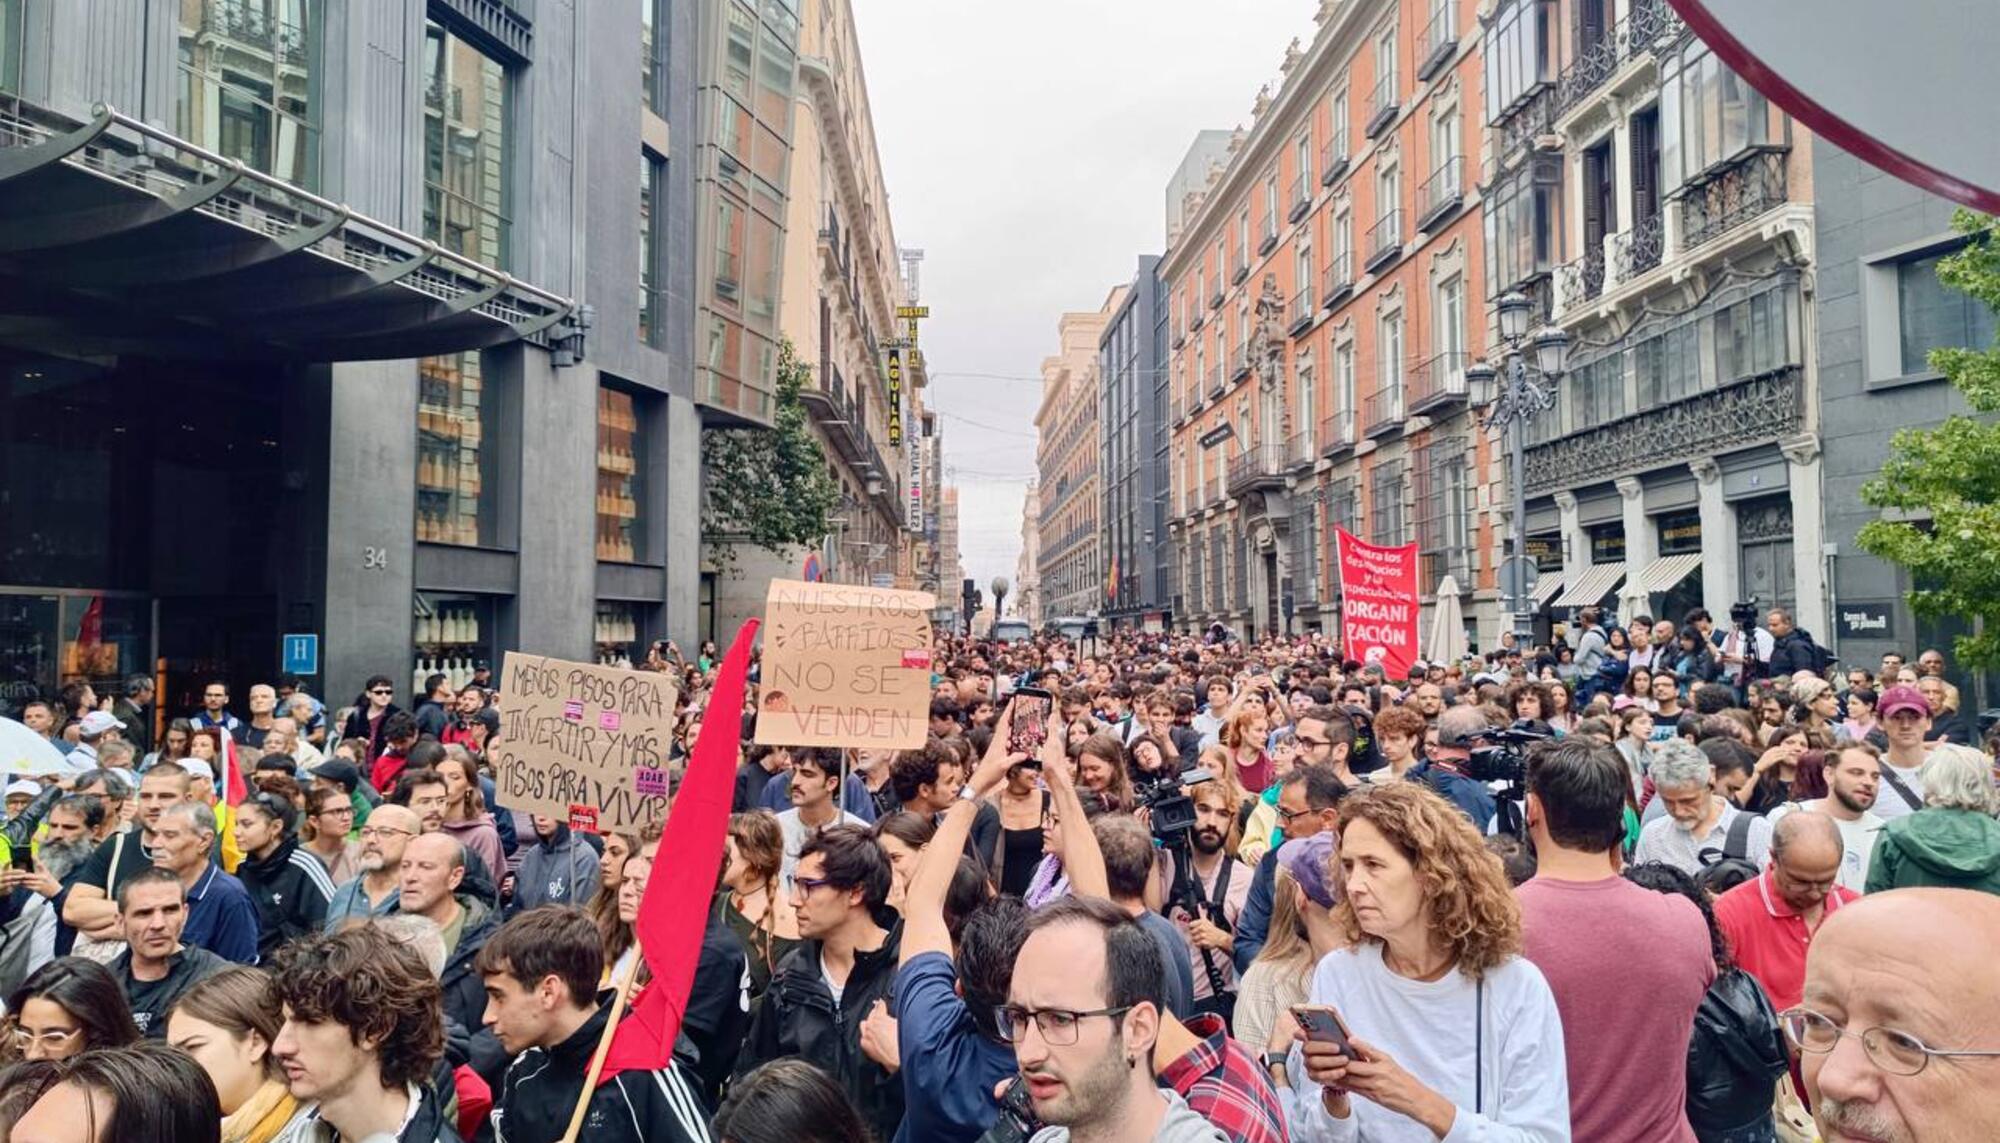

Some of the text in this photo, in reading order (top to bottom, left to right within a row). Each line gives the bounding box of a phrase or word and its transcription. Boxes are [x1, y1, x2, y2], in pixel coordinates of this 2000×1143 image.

[889, 356, 899, 439] AGUILAR
[364, 546, 387, 569] 34
[1384, 552, 1402, 564] los
[1364, 574, 1372, 585] y
[777, 589, 921, 619] NUESTROS
[1347, 601, 1408, 622] ORGANI
[294, 639, 307, 660] H
[1347, 623, 1406, 646] ZACIÓN
[512, 658, 560, 699] MENOS
[567, 669, 615, 710] PISOS
[619, 676, 662, 718] PARA
[773, 661, 900, 695] NO SE
[792, 705, 910, 739] VENDEN
[505, 705, 595, 764] INVERTIR
[600, 732, 620, 768] Y
[620, 728, 661, 770] MÁS
[500, 753, 544, 799] PISOS
[549, 762, 587, 806] PARA
